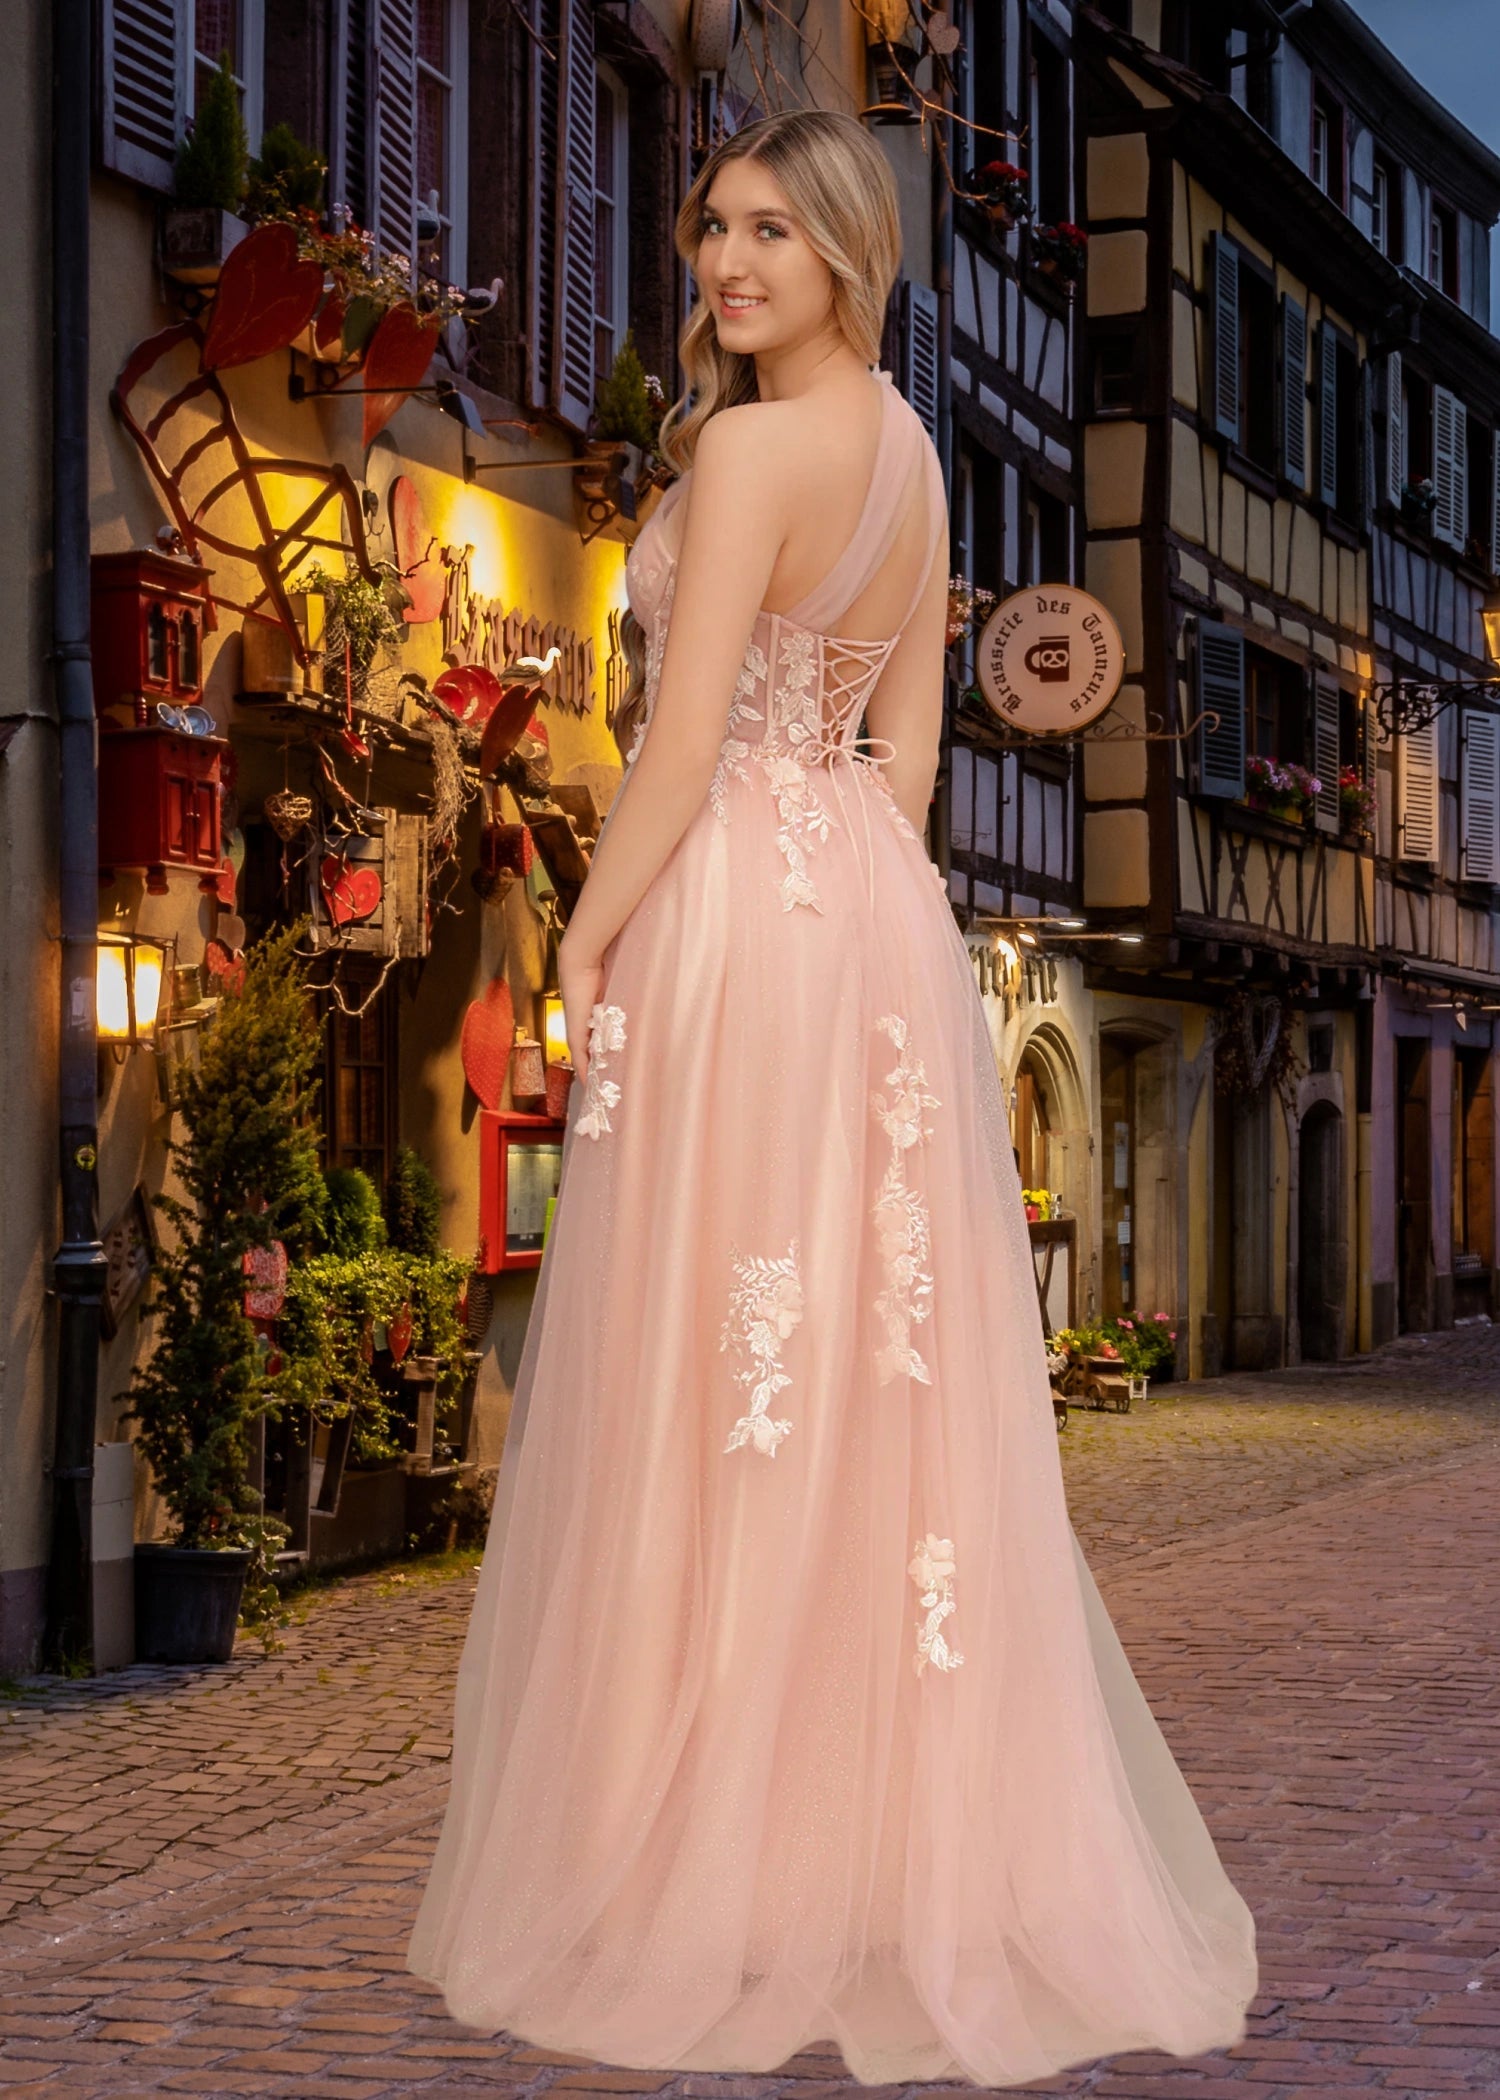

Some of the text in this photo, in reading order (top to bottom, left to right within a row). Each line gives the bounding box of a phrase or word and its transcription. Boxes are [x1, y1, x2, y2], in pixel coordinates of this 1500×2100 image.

[991, 596, 1108, 715] Brasserie des Tanneurs
